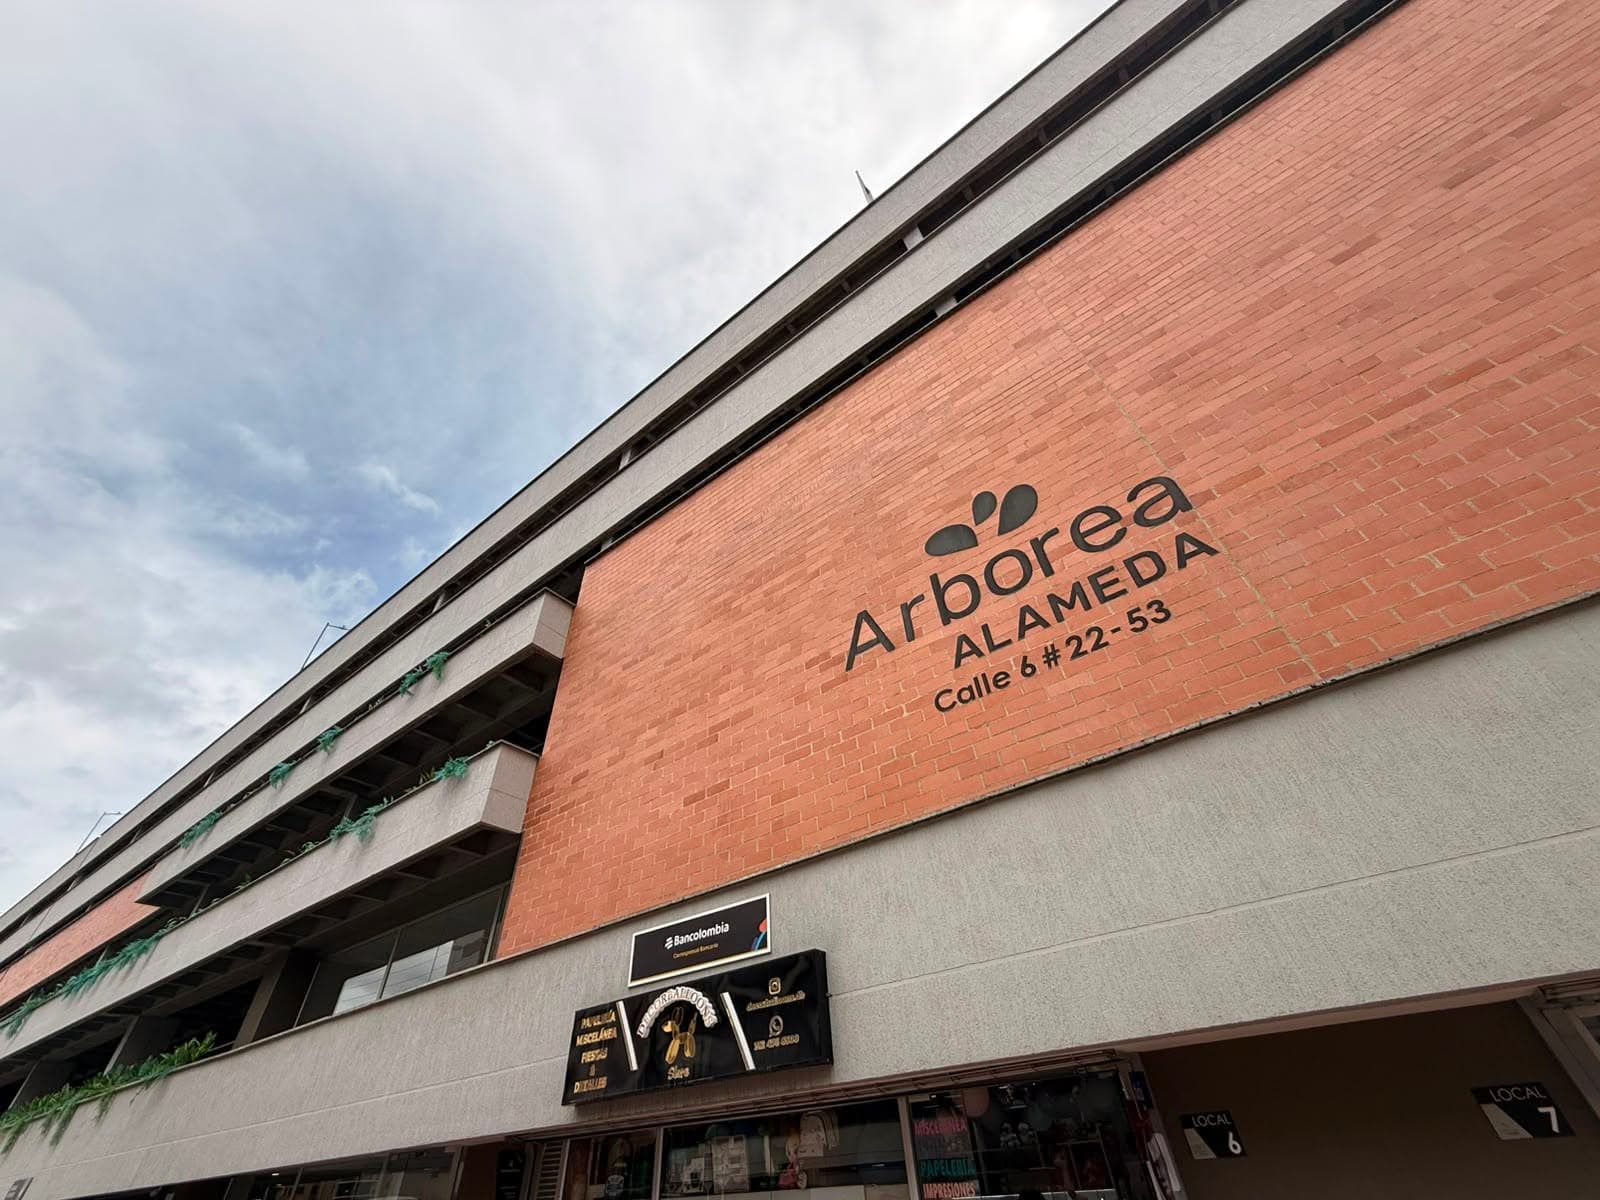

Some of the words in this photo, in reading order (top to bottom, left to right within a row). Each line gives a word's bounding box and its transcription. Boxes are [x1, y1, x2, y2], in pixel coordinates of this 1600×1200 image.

[845, 475, 1193, 672] Arborea
[954, 531, 1219, 668] ALAMEDA
[934, 670, 1011, 713] Calle
[1020, 655, 1037, 678] 6
[674, 921, 730, 946] Bancolombia
[1489, 1086, 1547, 1103] LOCAL
[1192, 1113, 1232, 1127] LOCAL
[1536, 1105, 1560, 1134] 7
[1228, 1131, 1243, 1155] 6
